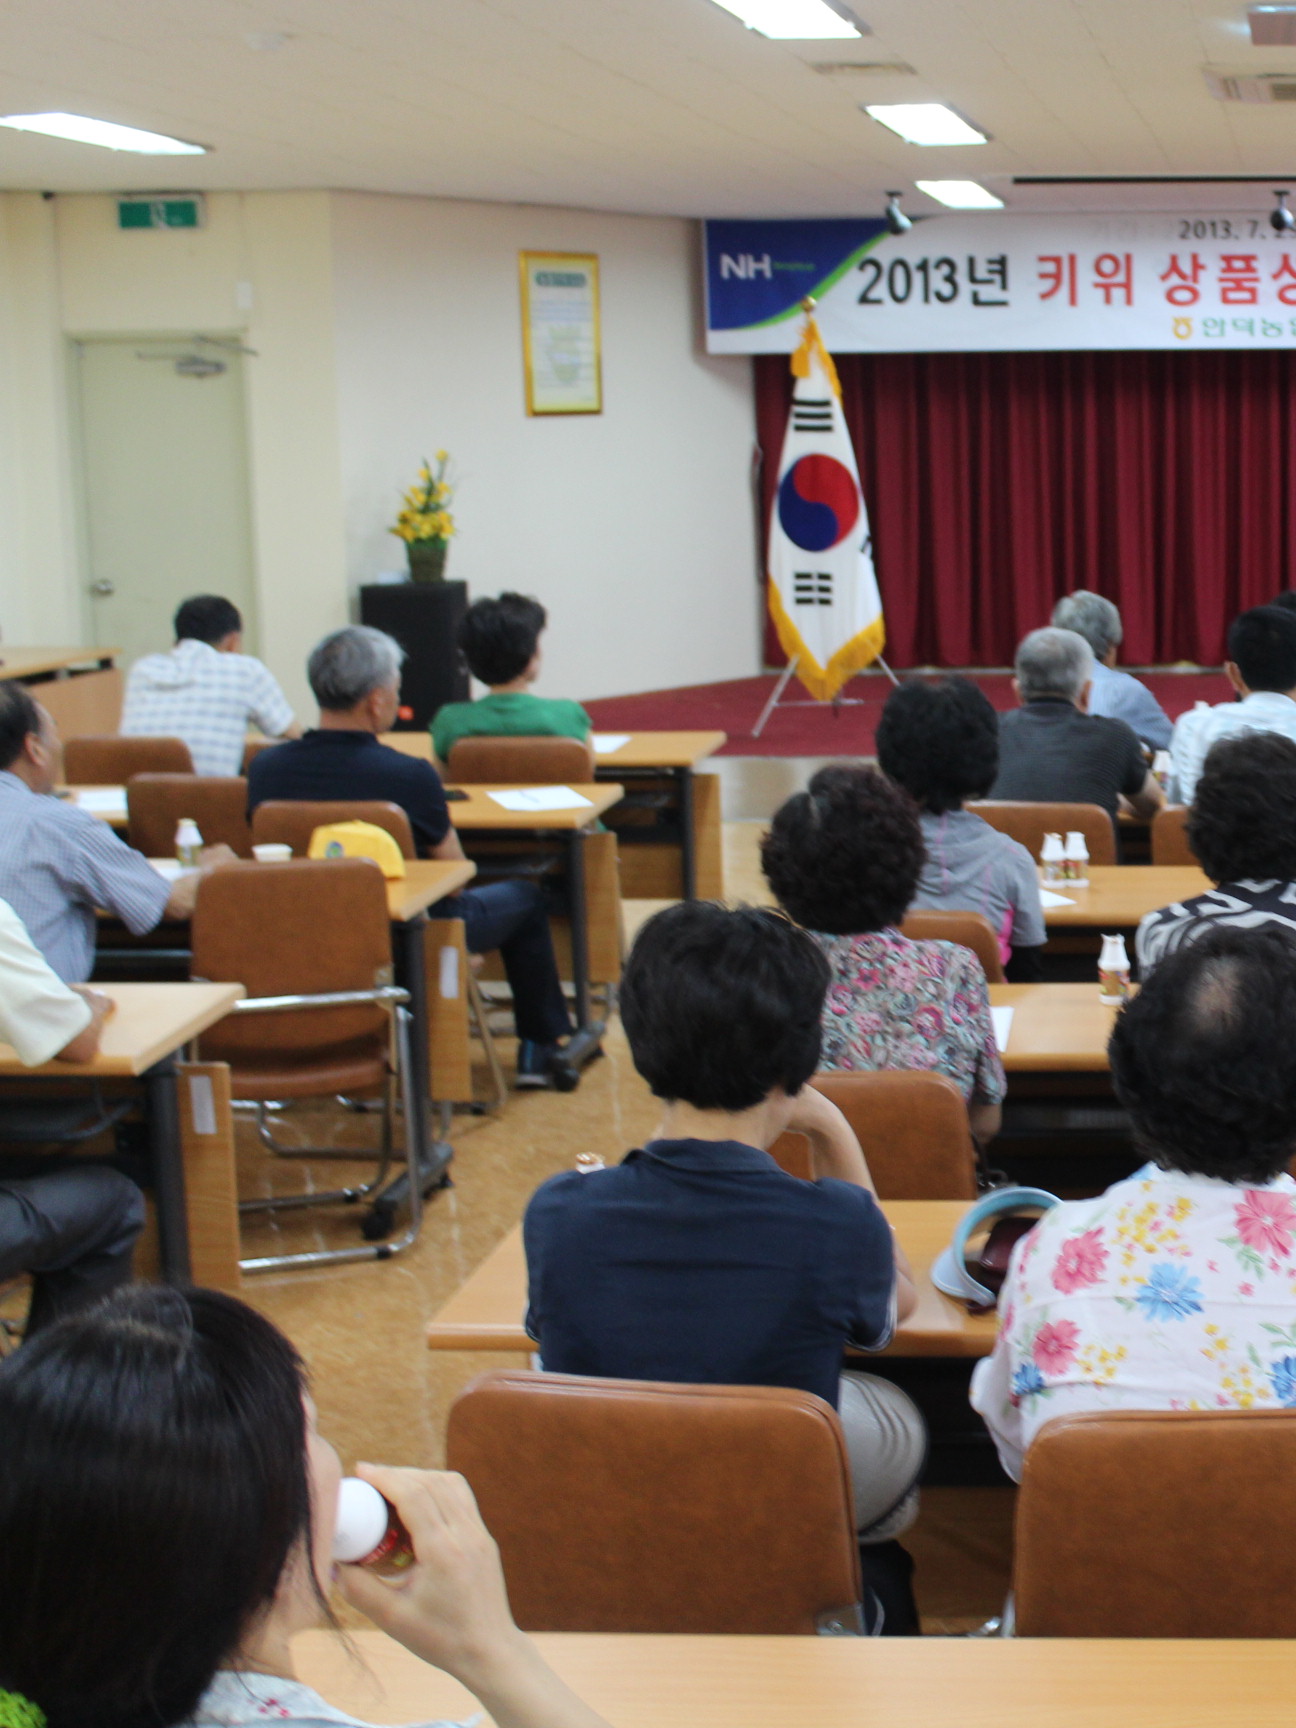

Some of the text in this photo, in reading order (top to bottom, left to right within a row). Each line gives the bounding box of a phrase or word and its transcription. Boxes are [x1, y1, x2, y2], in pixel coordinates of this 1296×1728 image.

[1179, 220, 1239, 240] 2013.
[1247, 219, 1267, 240] 7.
[720, 253, 772, 279] NH
[857, 254, 1010, 307] 2013년
[1037, 253, 1132, 307] 키위
